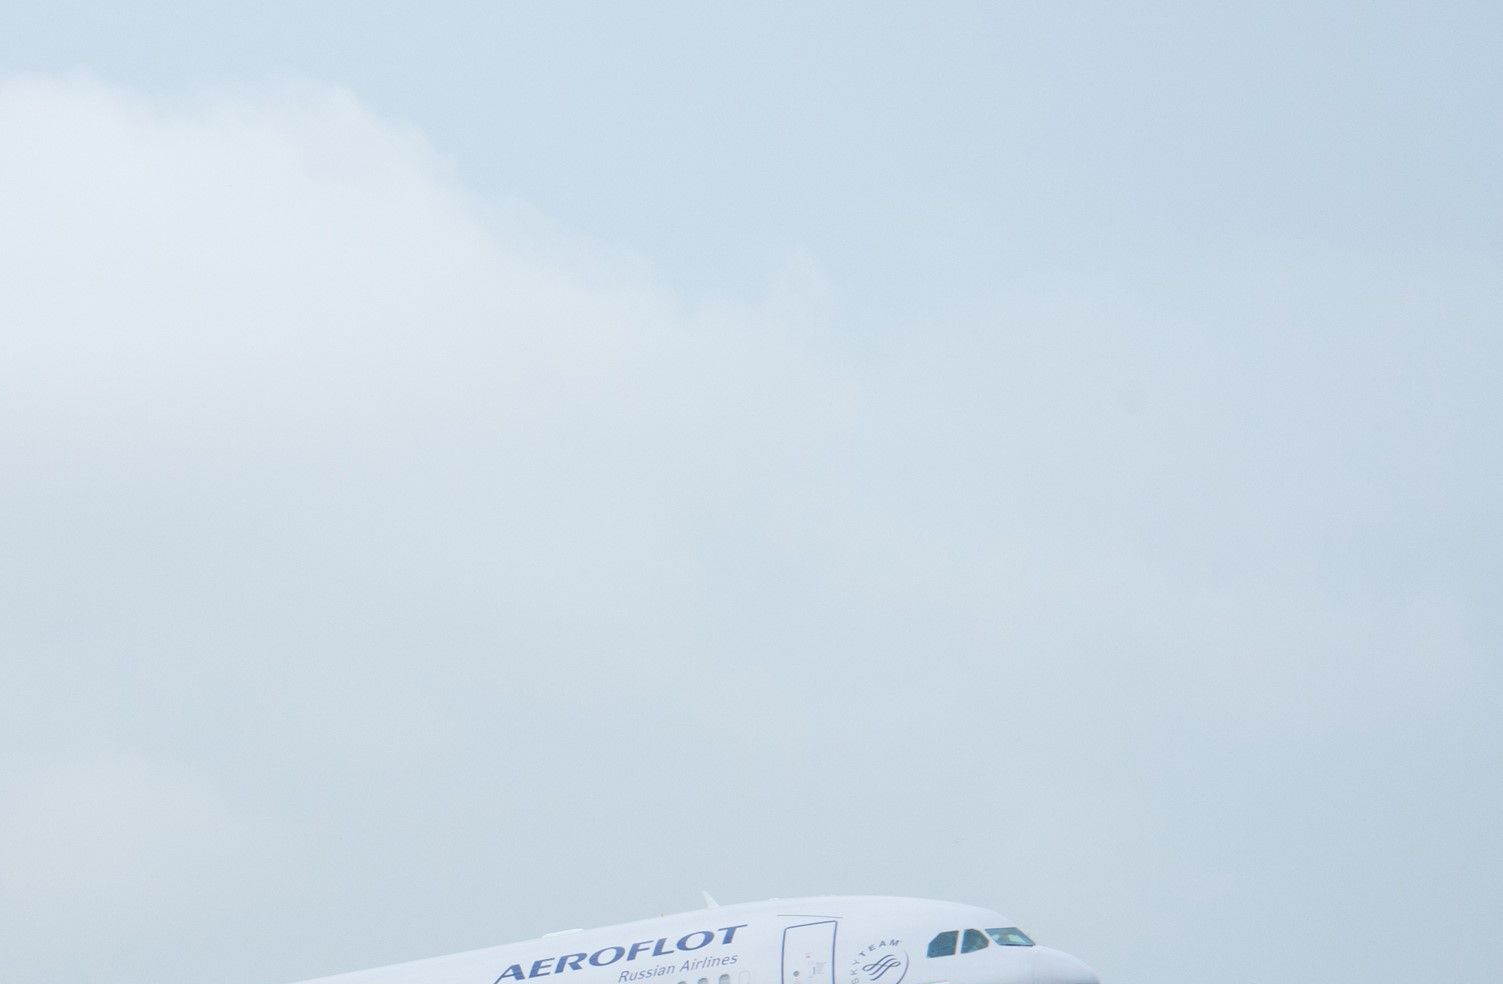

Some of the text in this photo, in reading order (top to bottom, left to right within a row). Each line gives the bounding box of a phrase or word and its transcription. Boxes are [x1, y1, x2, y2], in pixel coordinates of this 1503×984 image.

[493, 923, 748, 984] AEROFLOT
[618, 953, 739, 983] Russian Airlines
